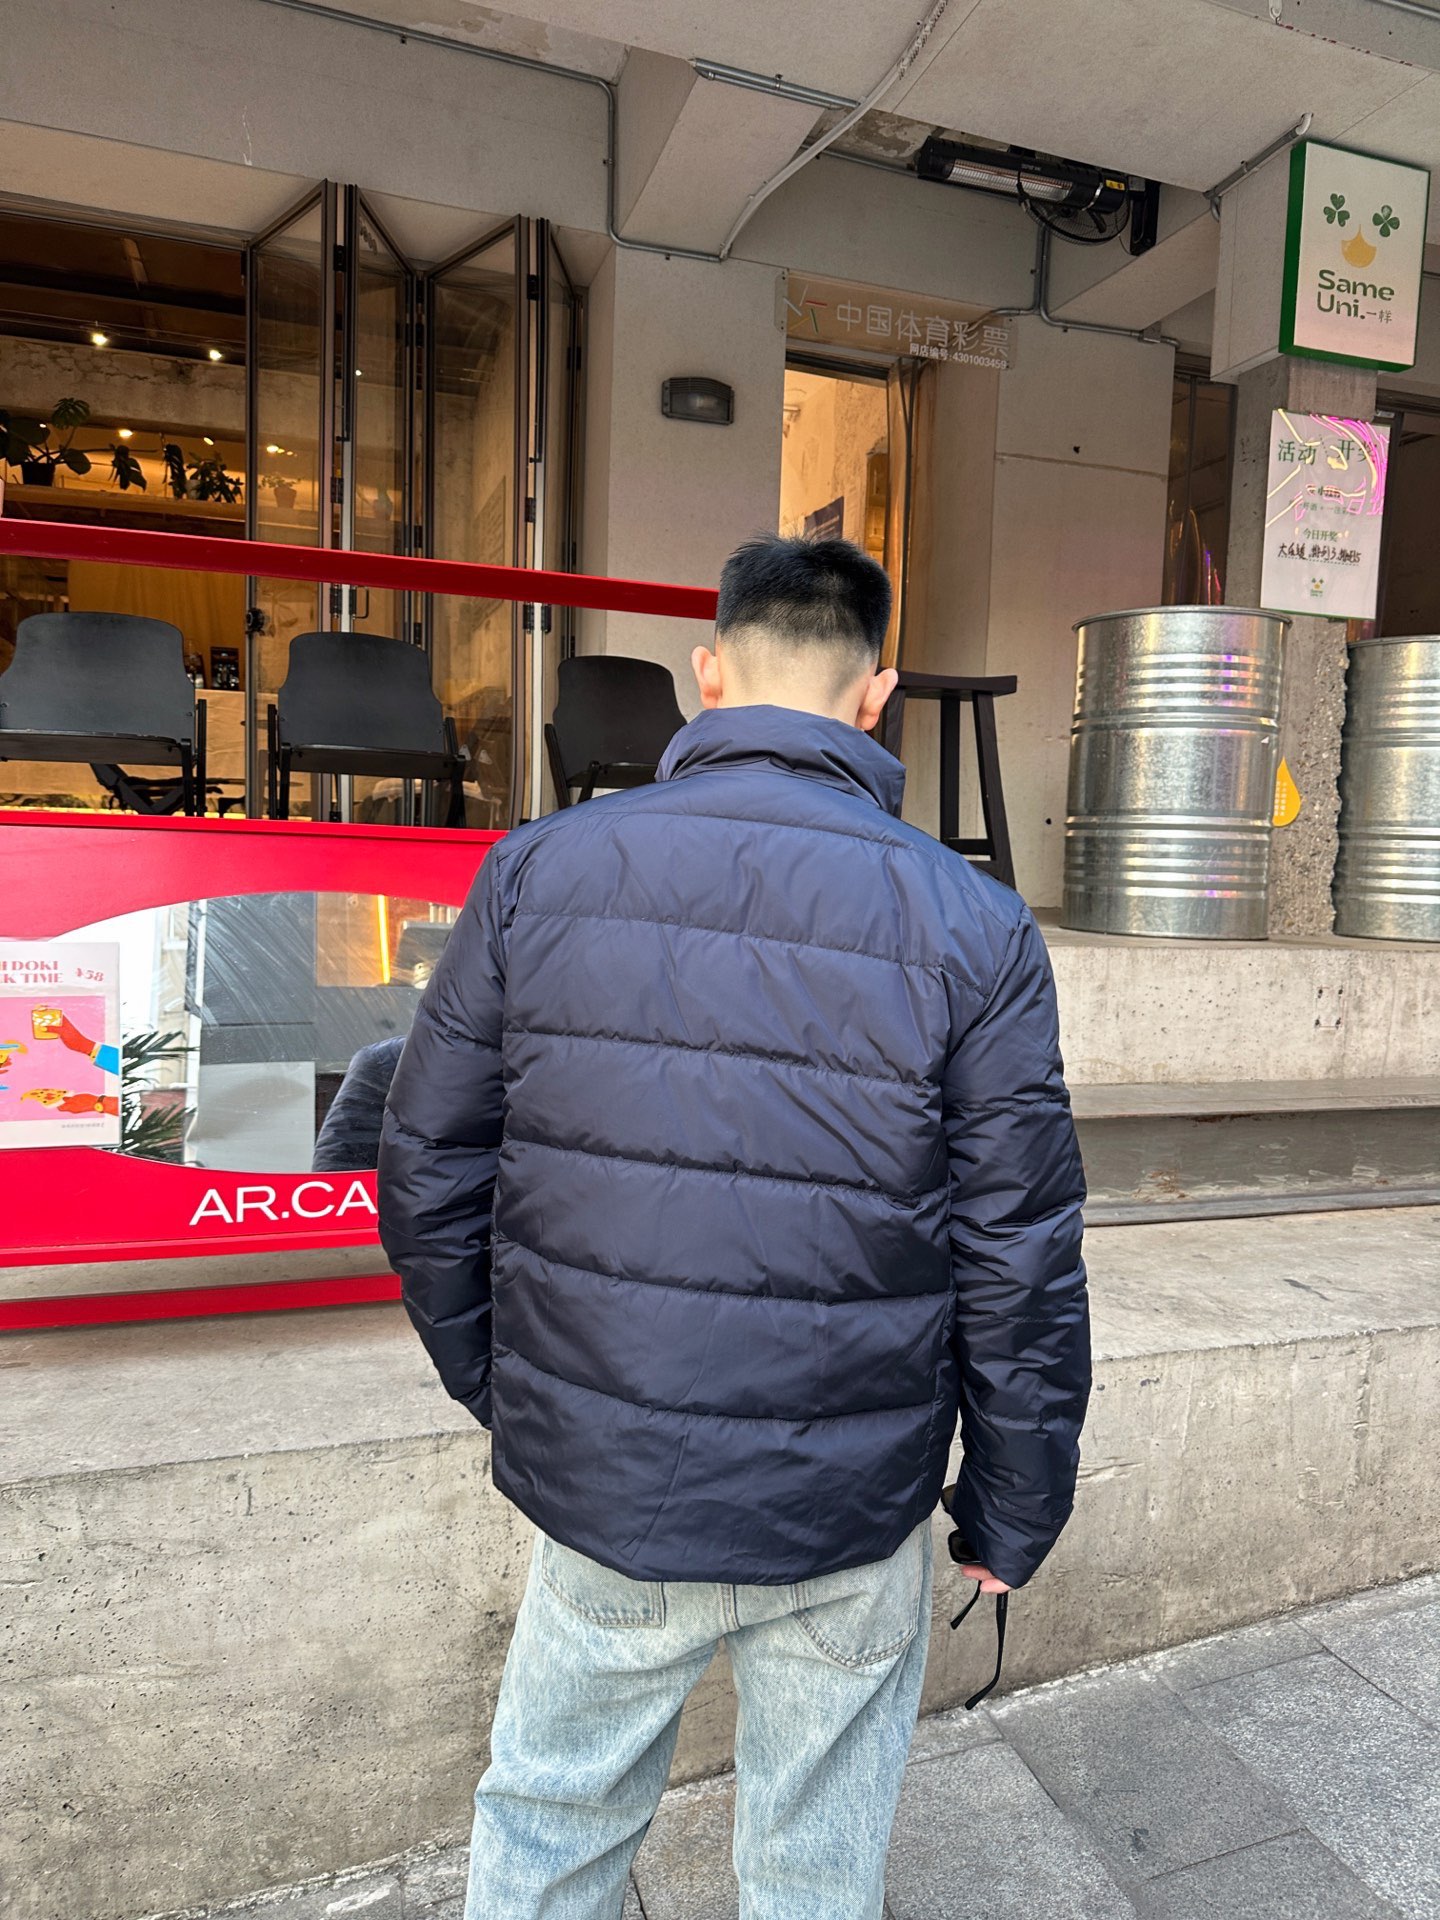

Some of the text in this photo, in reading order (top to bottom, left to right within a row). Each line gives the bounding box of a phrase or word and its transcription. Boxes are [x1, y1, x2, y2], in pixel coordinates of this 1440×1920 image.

[1318, 269, 1395, 301] Same
[836, 301, 1010, 357] 中国体育彩票
[1277, 438, 1317, 466] 活动
[12, 961, 58, 971] DOKI
[20, 973, 63, 983] TIME
[188, 1180, 378, 1226] AR.CA
